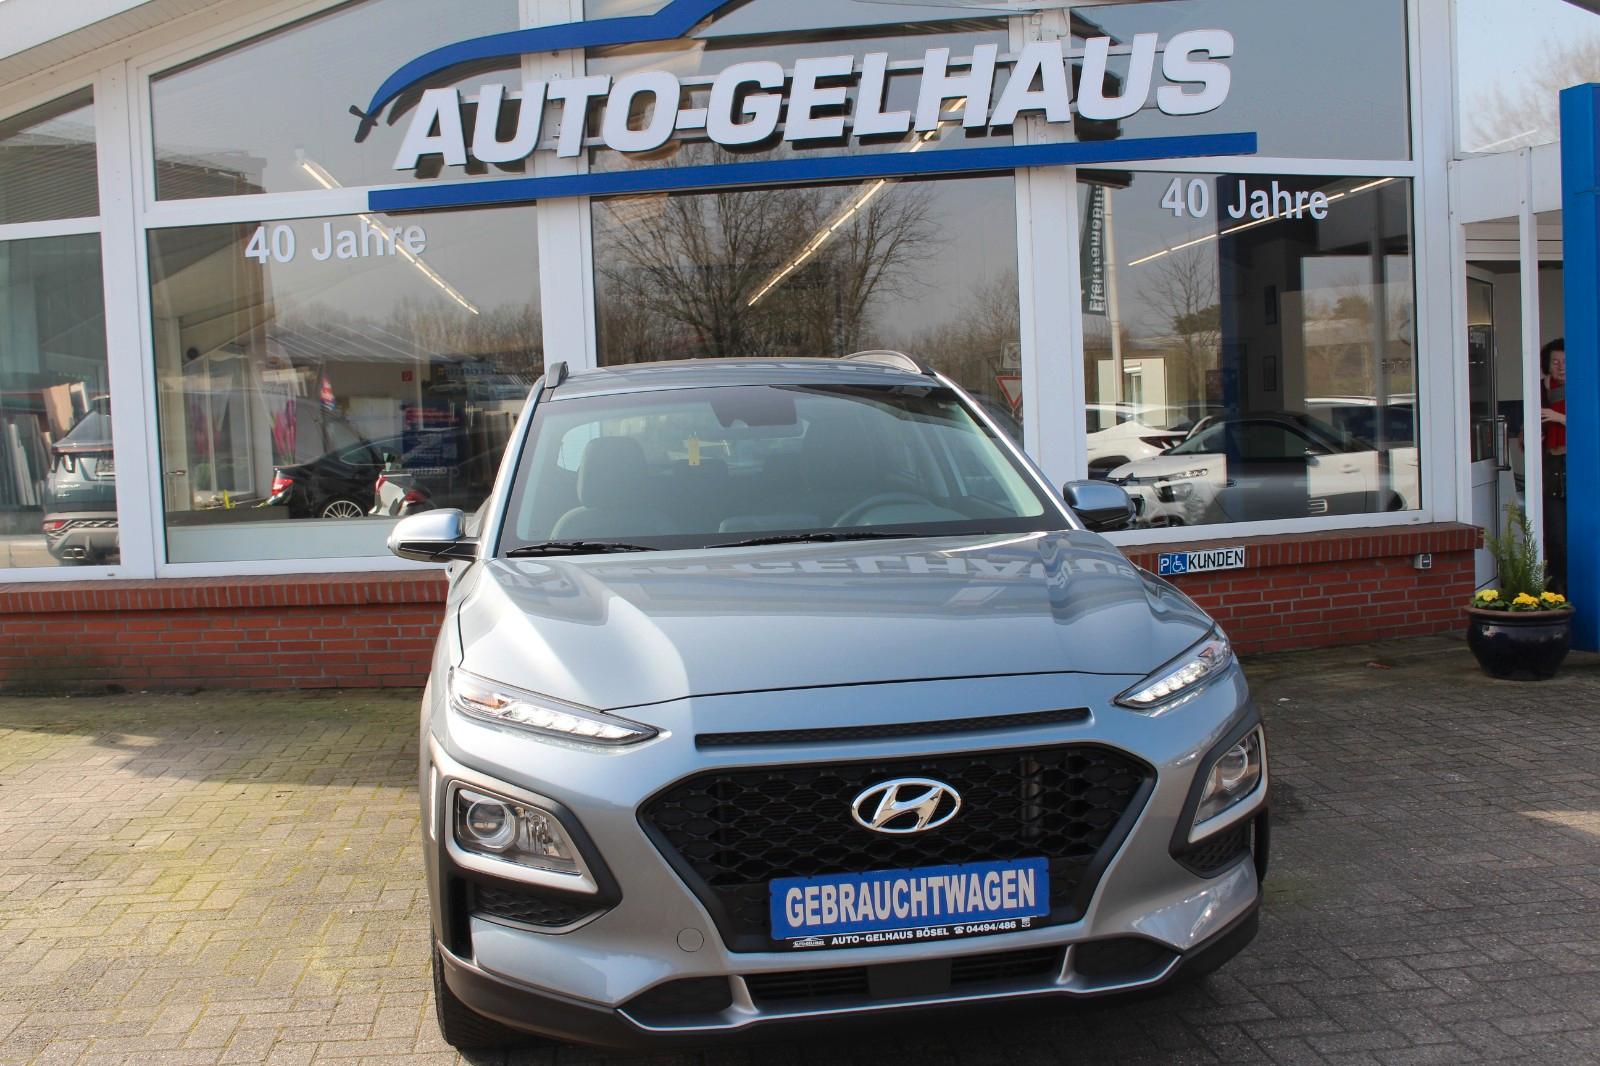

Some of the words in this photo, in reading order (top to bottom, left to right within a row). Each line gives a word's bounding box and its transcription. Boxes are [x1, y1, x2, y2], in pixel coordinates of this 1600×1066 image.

[391, 28, 1235, 171] AUTO-GELHAUS
[1160, 177, 1209, 218] 40
[1227, 178, 1329, 221] Jahre
[244, 224, 297, 265] 40
[311, 221, 427, 262] Jahre
[1160, 558, 1170, 572] P
[1188, 549, 1244, 570] KUNDEN
[785, 868, 1036, 928] GEBRAUCHTWAGEN
[831, 930, 914, 945] AUTO-GELHAUS
[916, 927, 950, 938] BÖSEL
[966, 920, 1017, 934] 04494/486
